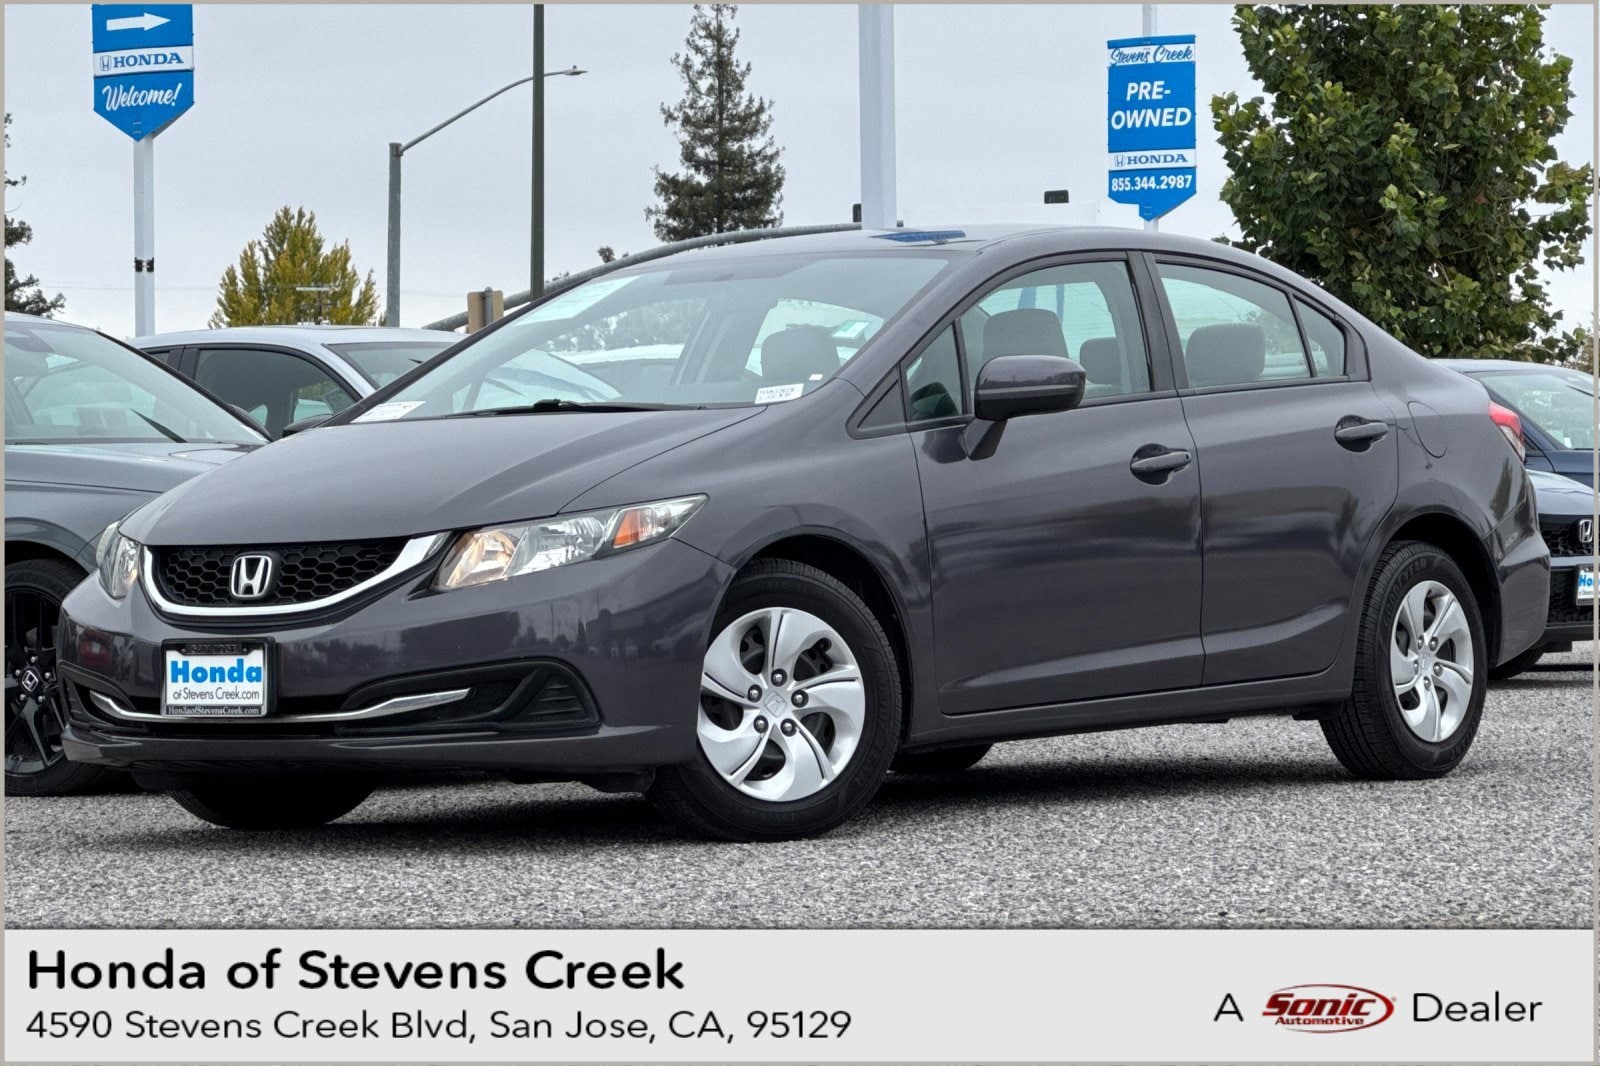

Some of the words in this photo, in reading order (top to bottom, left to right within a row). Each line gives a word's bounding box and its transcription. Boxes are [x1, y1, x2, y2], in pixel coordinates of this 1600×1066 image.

[113, 52, 184, 68] HONDA
[1110, 48, 1151, 66] Stevens
[1152, 44, 1194, 63] Creek
[102, 82, 183, 111] Welcome!
[1126, 80, 1172, 101] PRE-
[1111, 107, 1193, 130] OWNED
[1126, 153, 1189, 165] HONDA
[1111, 174, 1193, 192] 855.344.2987
[170, 658, 262, 684] Honda
[172, 689, 183, 700] of
[183, 686, 215, 700] Stevens
